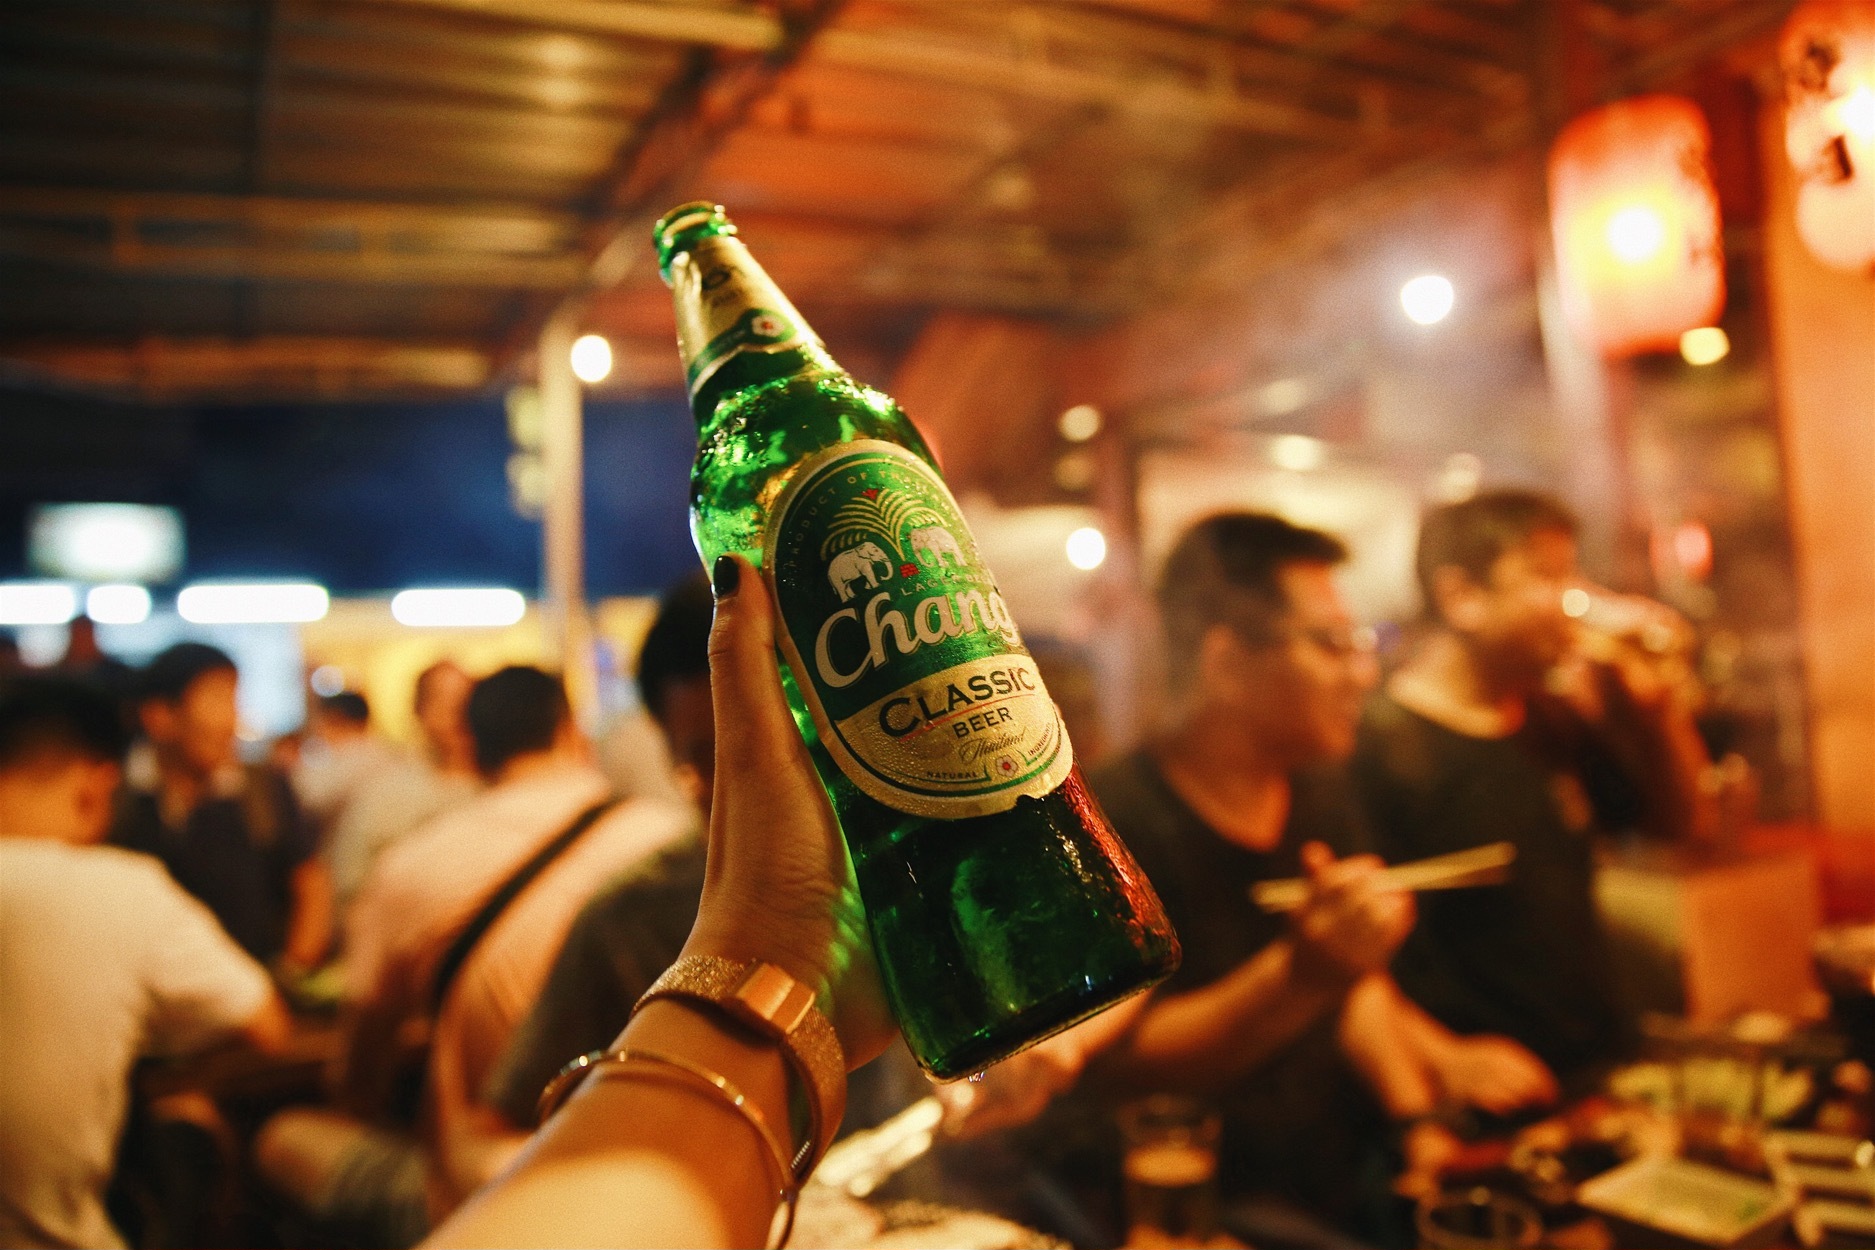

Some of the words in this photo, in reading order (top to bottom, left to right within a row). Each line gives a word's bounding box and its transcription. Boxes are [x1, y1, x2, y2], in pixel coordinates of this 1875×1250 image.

[847, 471, 868, 484] OF
[815, 588, 1021, 689] Chang
[878, 668, 1036, 738] CLASSIC
[952, 707, 1013, 739] BEER
[926, 770, 979, 779] NATURAL
